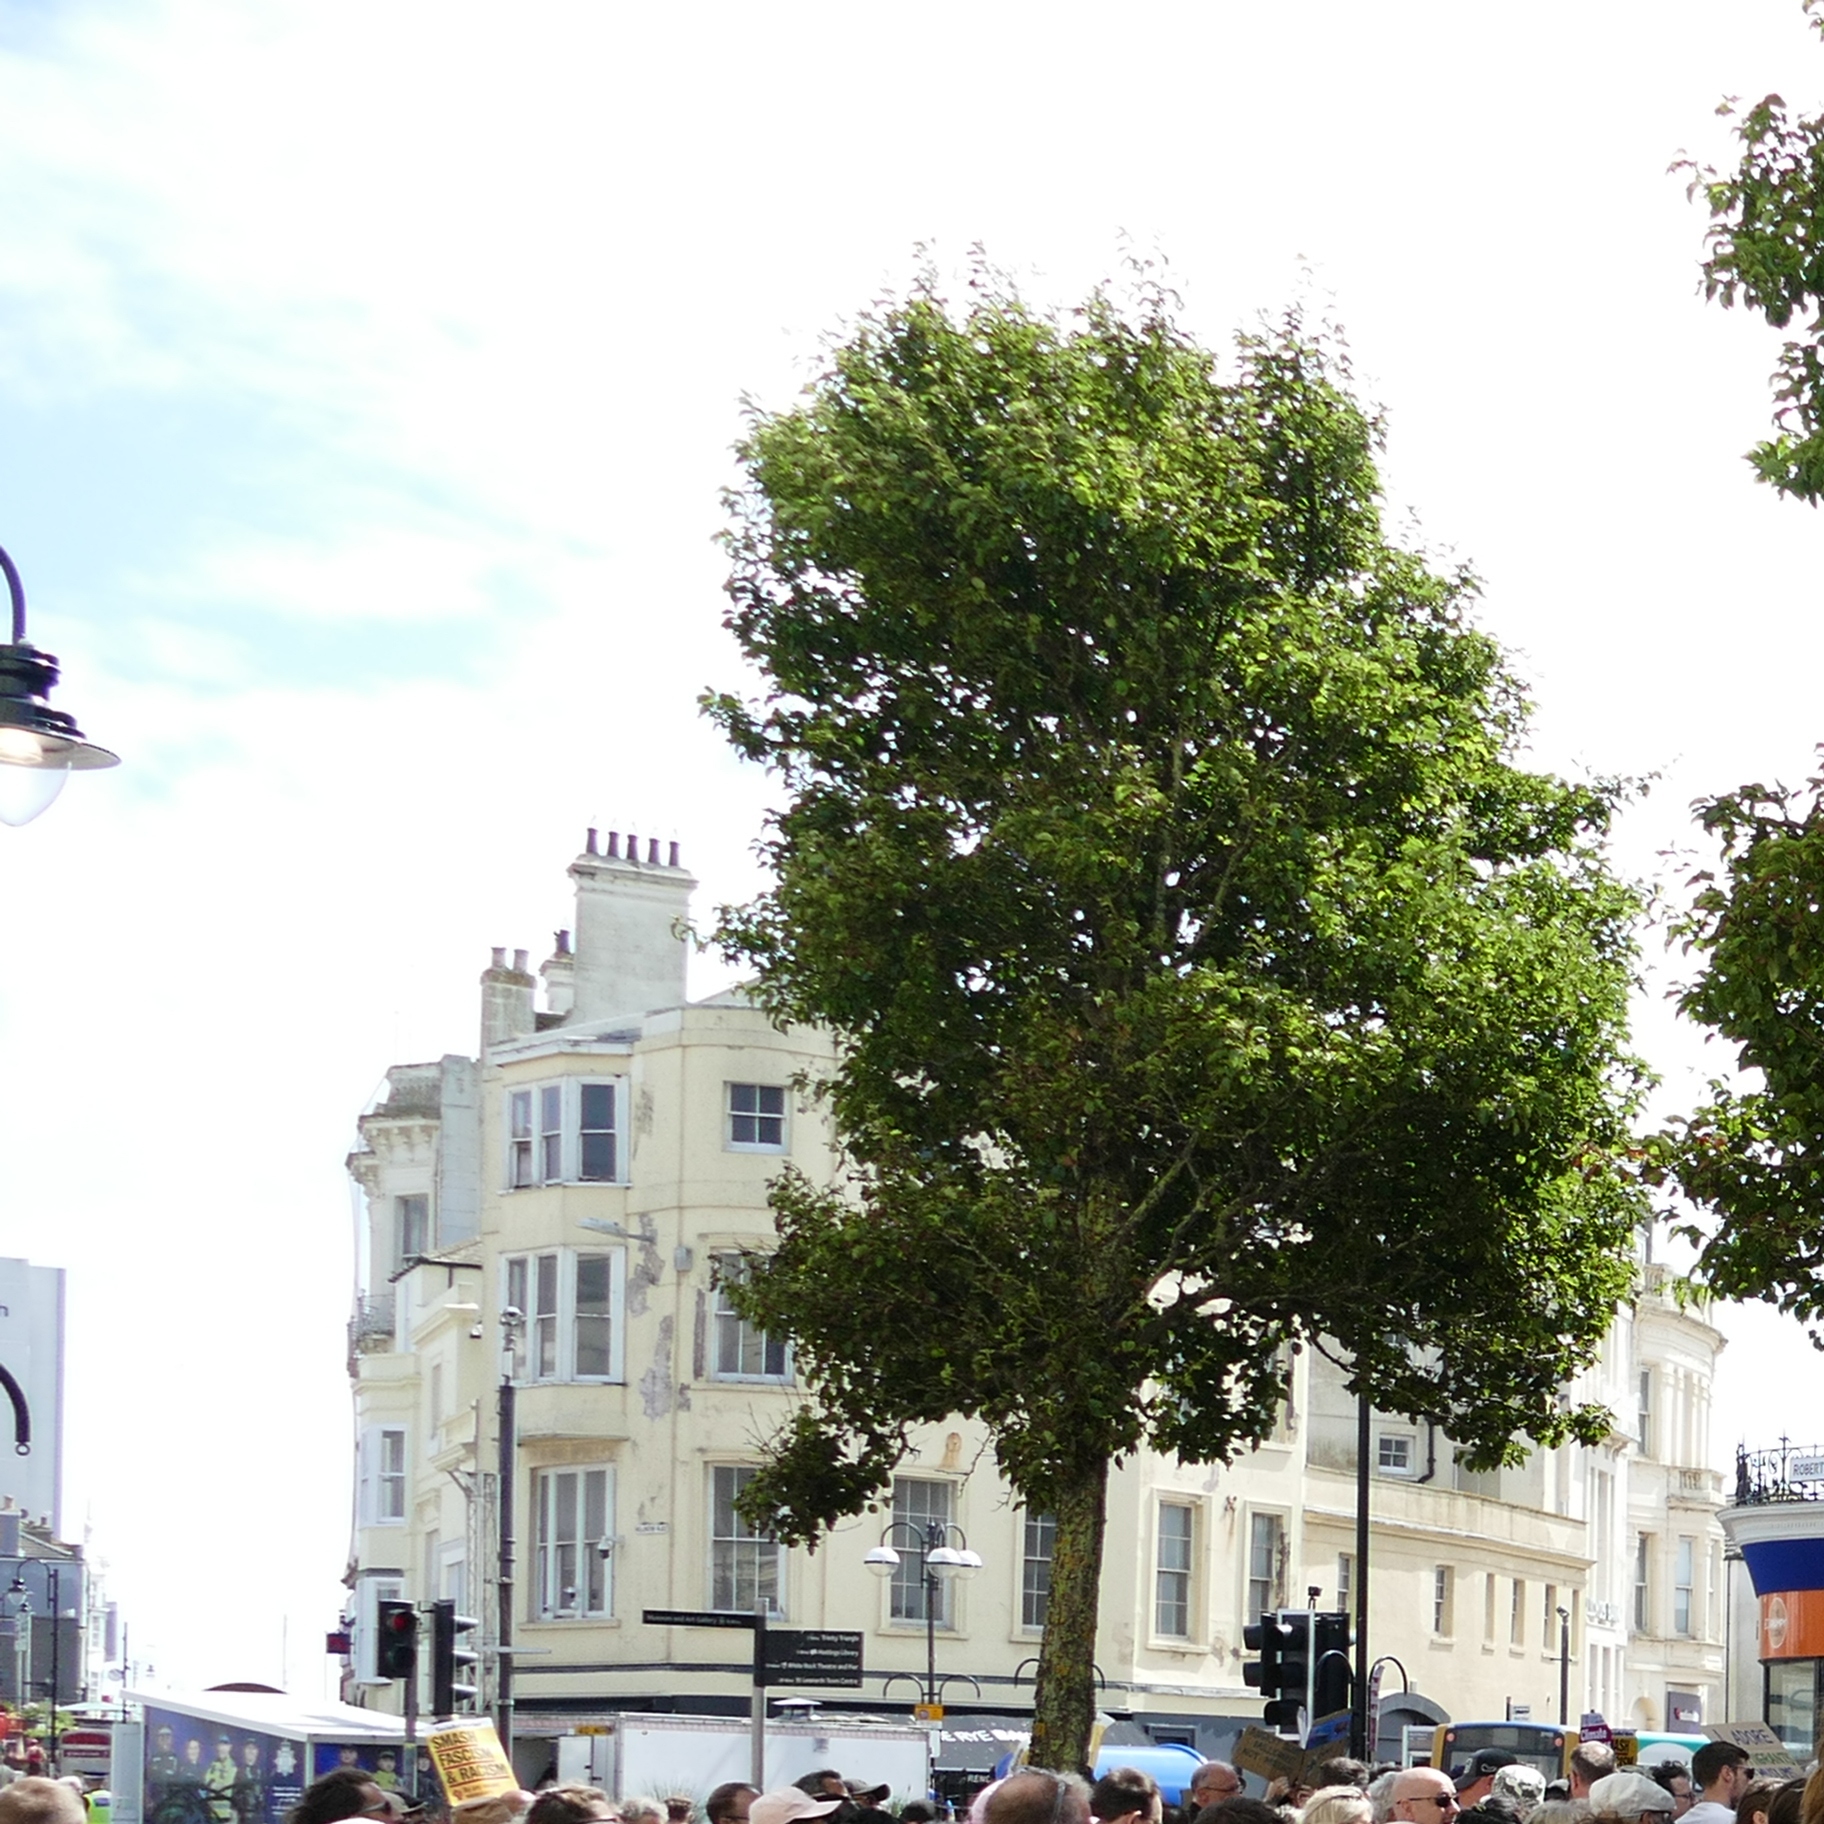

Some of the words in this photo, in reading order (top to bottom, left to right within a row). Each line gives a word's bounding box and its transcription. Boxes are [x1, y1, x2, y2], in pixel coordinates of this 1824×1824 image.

[432, 1730, 477, 1750] SMASH
[956, 1728, 994, 1744] RYE
[1731, 1728, 1774, 1746] ADORE
[438, 1747, 495, 1768] FASCISM
[446, 1770, 457, 1784] &
[459, 1763, 509, 1781] RACISM
